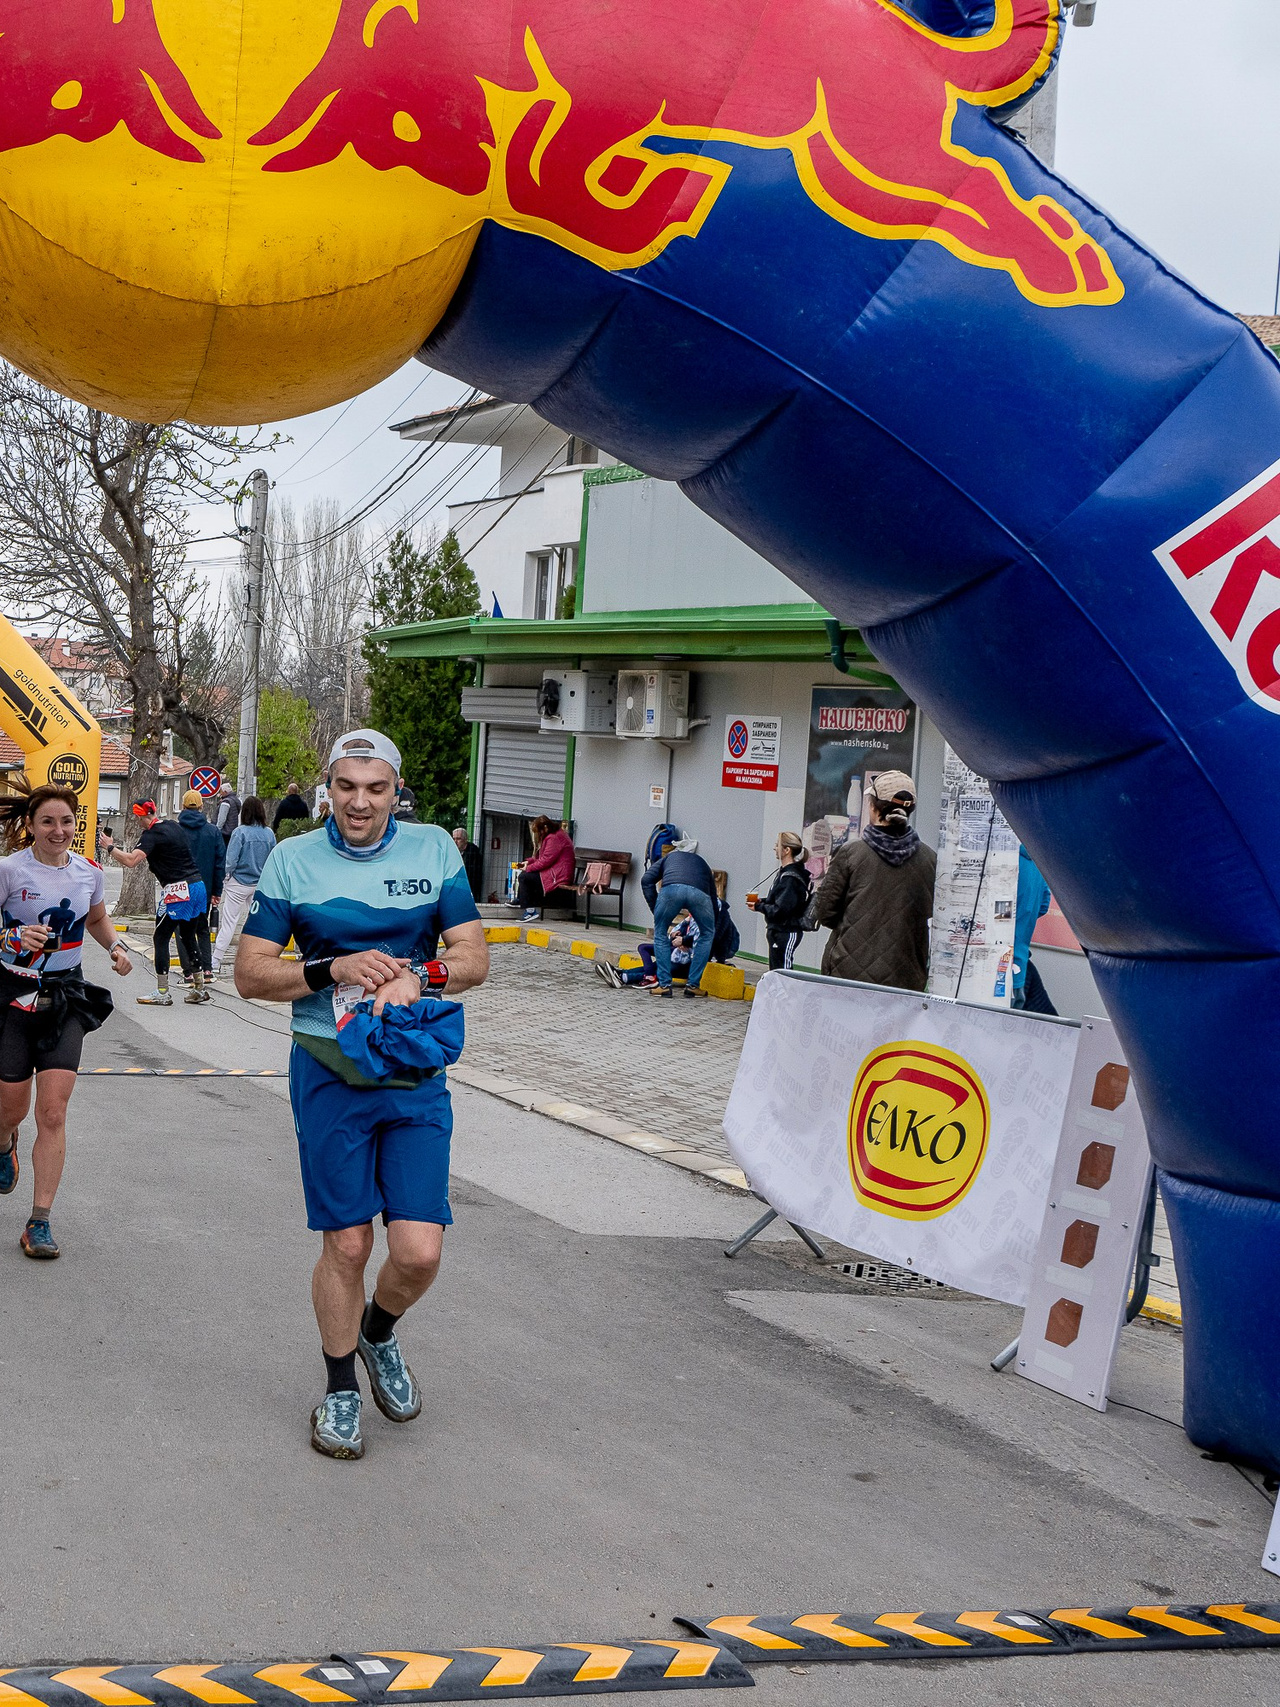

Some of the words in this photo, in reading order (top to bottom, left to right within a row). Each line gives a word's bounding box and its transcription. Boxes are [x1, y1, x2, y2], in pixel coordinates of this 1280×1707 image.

[13, 669, 69, 729] goldnutrition
[752, 721, 778, 730] СПИРАНЕТО
[819, 707, 907, 733] НАШЕНСКО
[752, 730, 778, 738] ЗАБРАНЕНО
[830, 737, 889, 750] www.nashensko.bg
[56, 762, 83, 774] GOLD
[725, 767, 744, 775] ПАРКИНГ
[744, 768, 750, 776] ЗА
[750, 769, 775, 778] ЗАРЕЖДАНЕ
[53, 772, 85, 782] NUTRITION
[961, 800, 990, 811] РЕМОНТ
[170, 883, 187, 892] 2245
